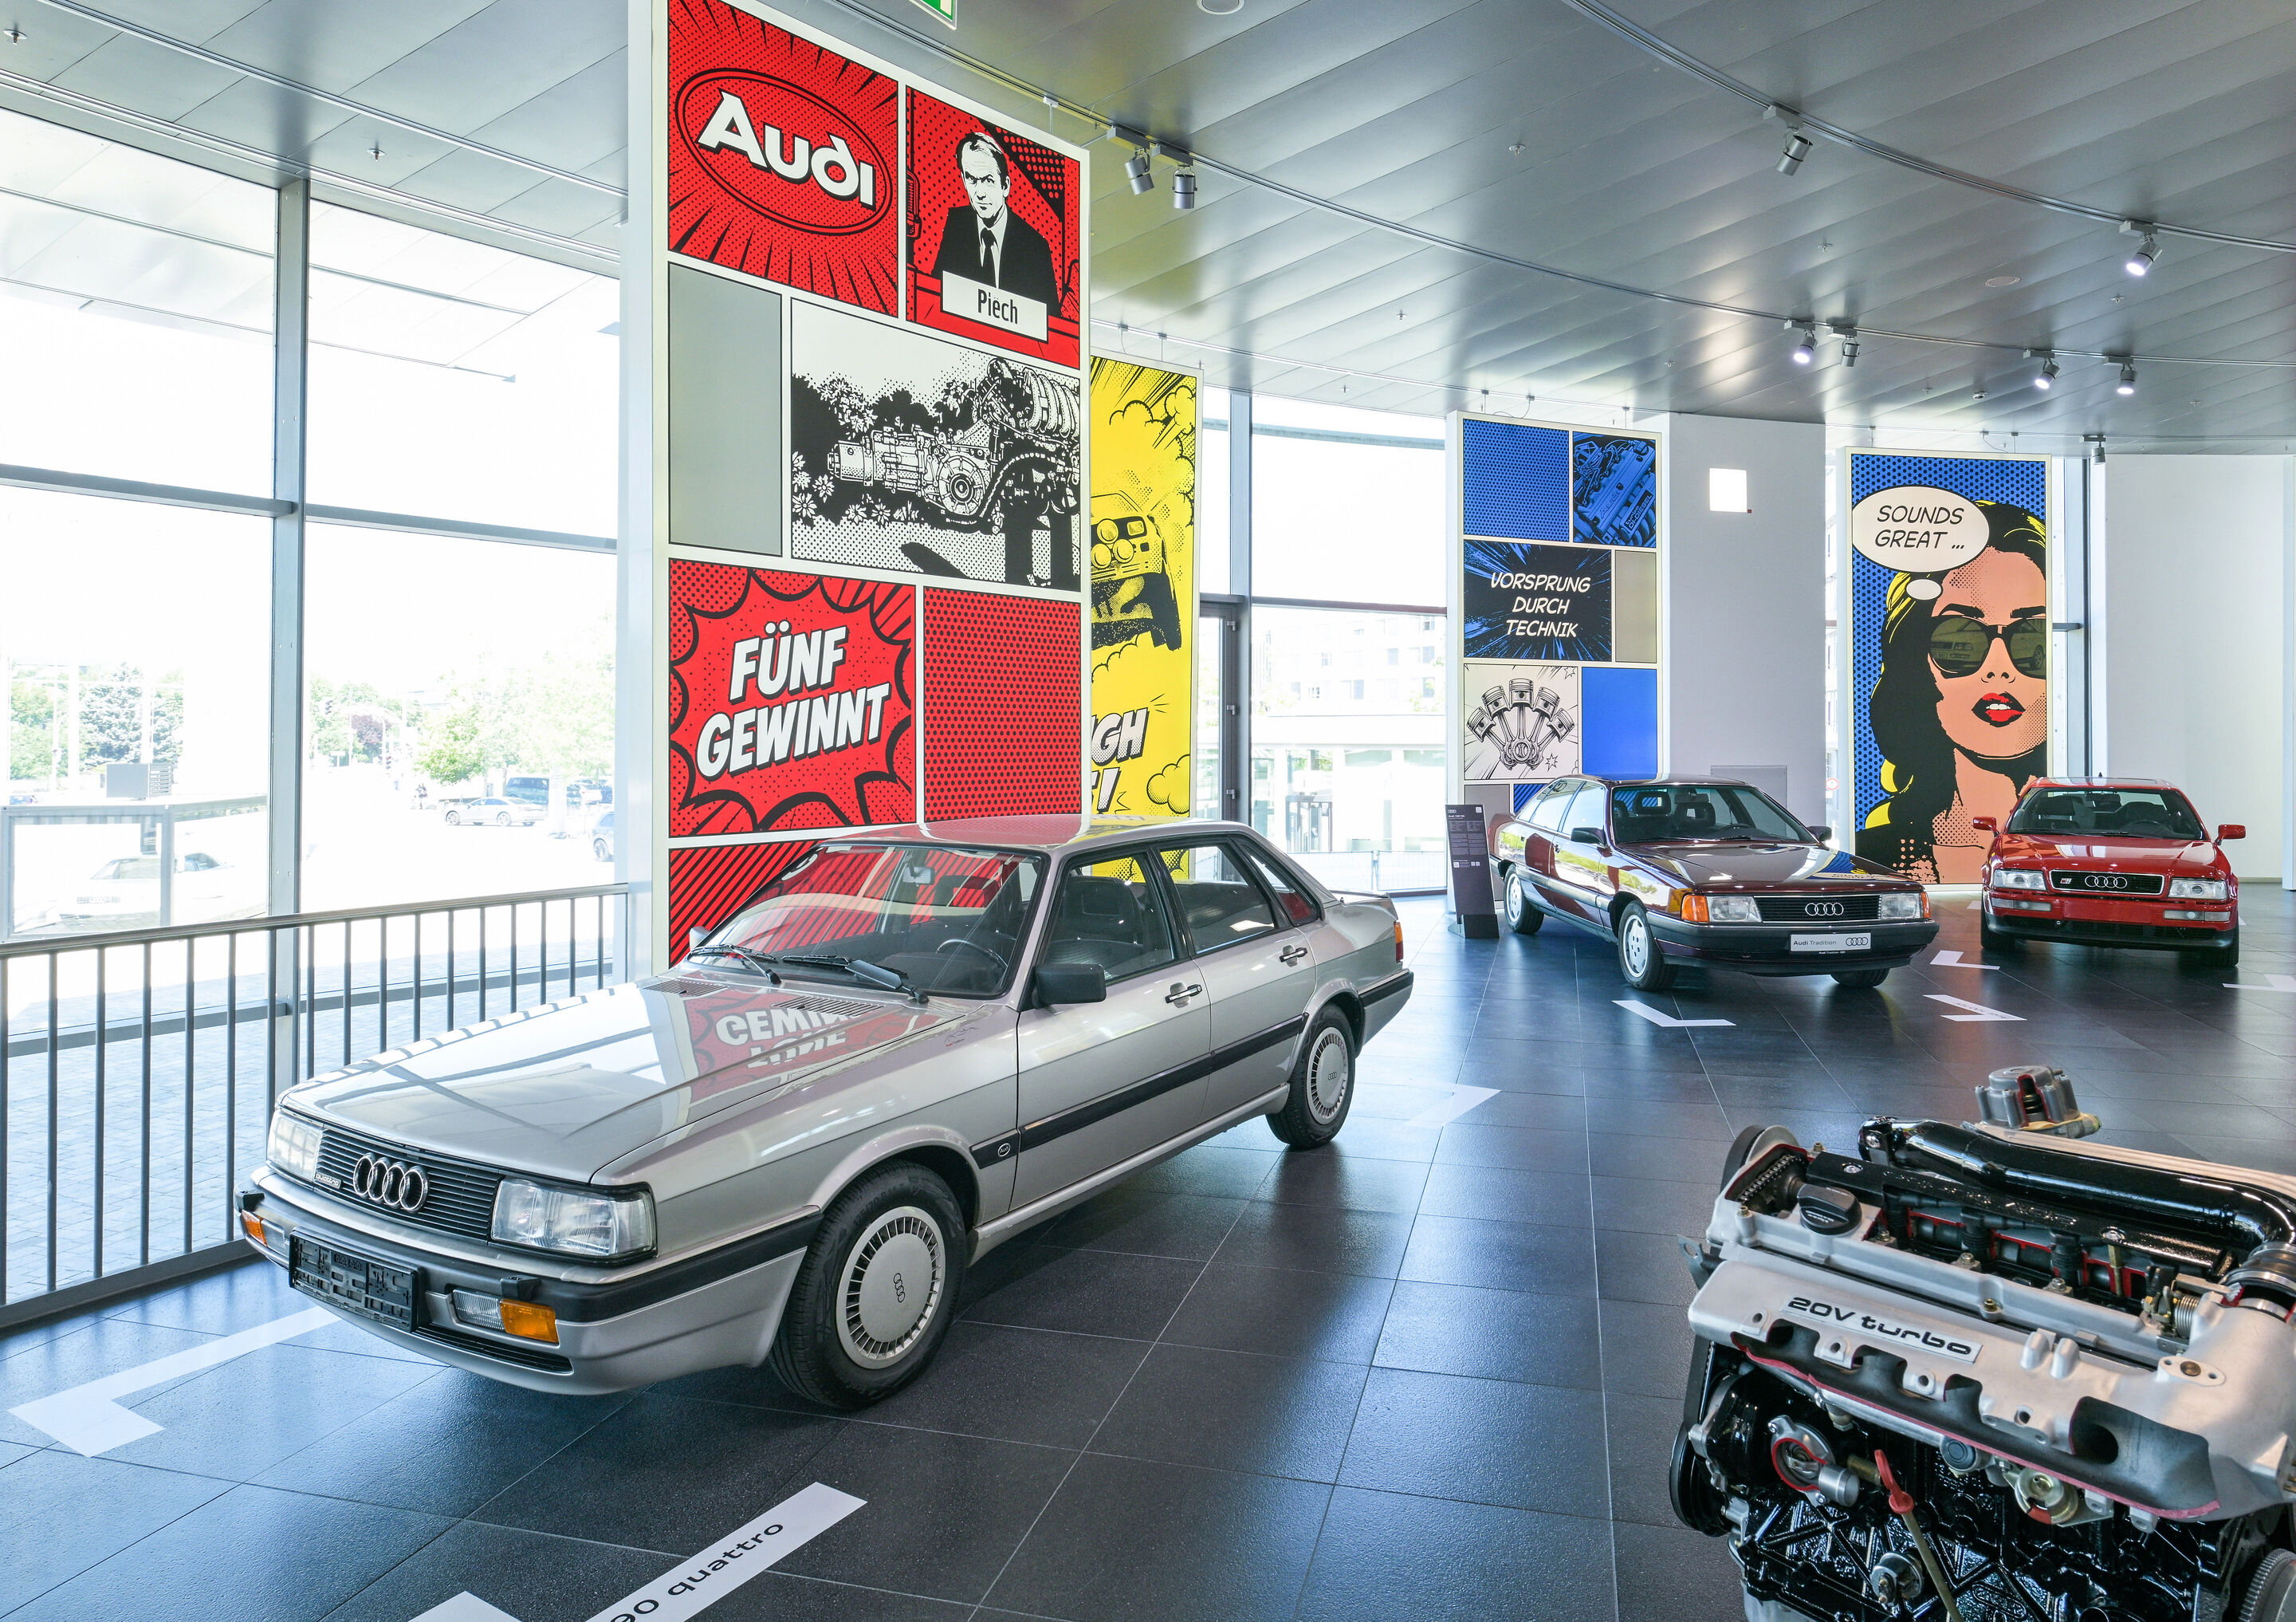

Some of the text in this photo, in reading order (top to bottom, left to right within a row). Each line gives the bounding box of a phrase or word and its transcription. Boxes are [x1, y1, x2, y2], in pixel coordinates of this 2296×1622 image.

[697, 90, 876, 209] Audi
[977, 288, 1018, 325] Piëch
[1875, 529, 1948, 549] GREAT
[1877, 505, 1964, 525] SOUNDS
[1490, 572, 1591, 593] VORSPRUNG
[1512, 596, 1570, 615] DURCH
[1505, 620, 1578, 638] TECHNIK
[729, 620, 850, 705] FÜNF
[696, 683, 892, 781] GEWINNT
[1091, 707, 1150, 766] GH
[1787, 1297, 1972, 1356] 20V turbo
[667, 1523, 784, 1596] quattro
